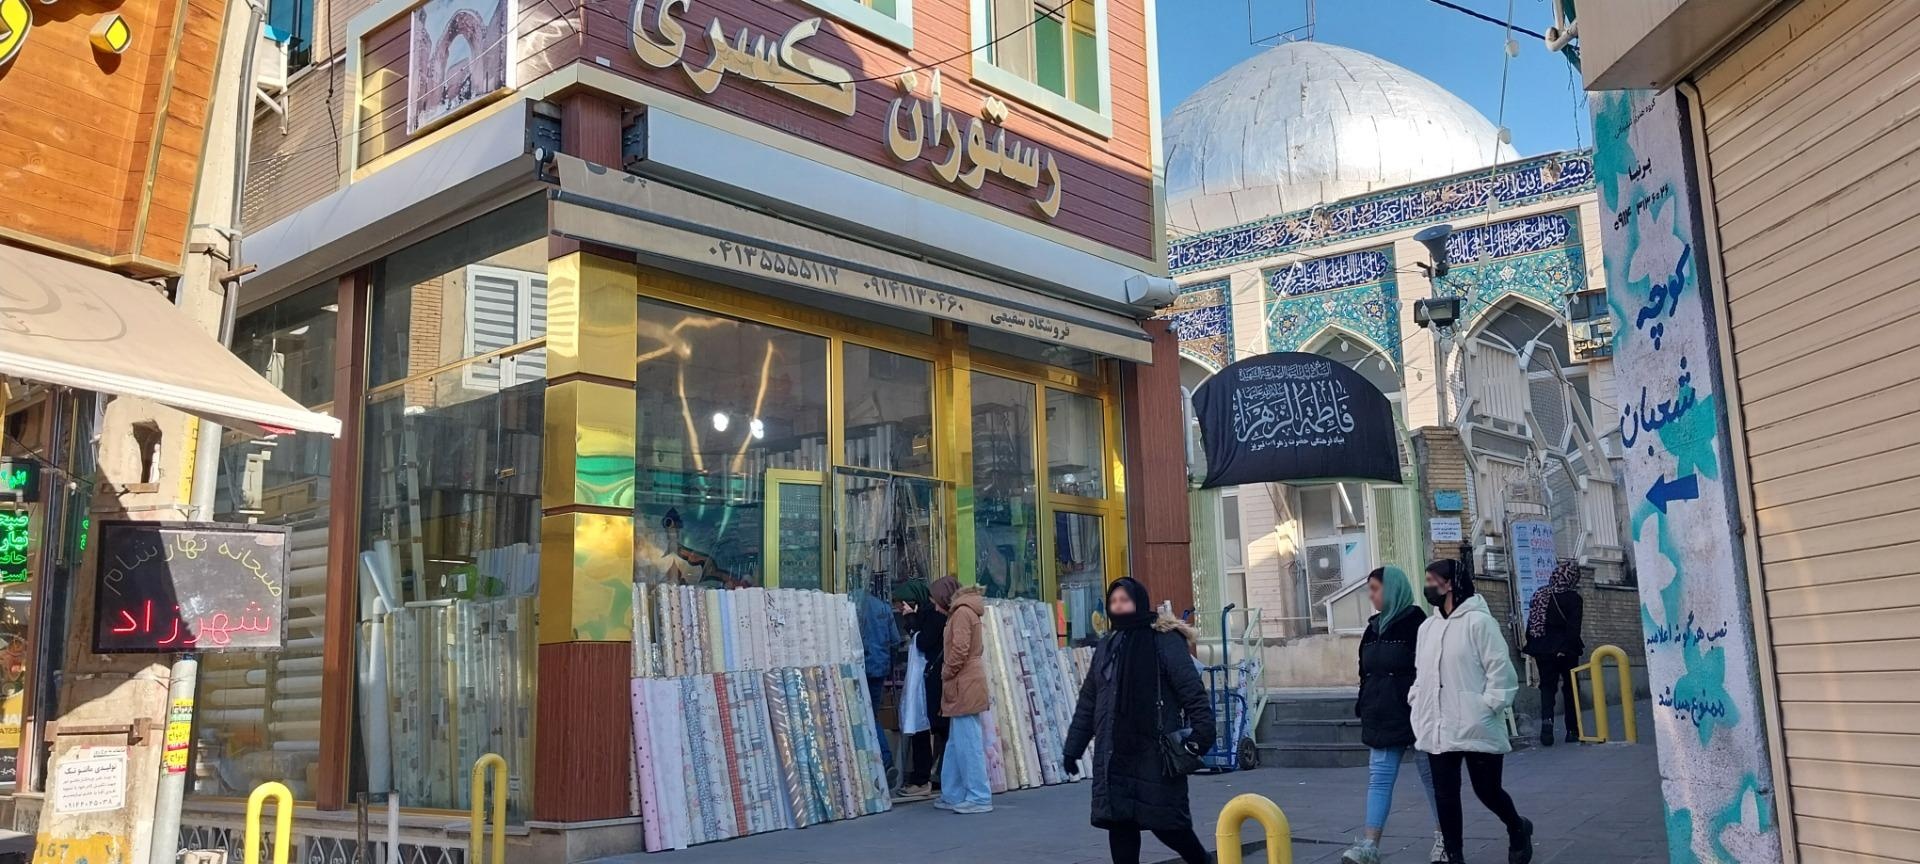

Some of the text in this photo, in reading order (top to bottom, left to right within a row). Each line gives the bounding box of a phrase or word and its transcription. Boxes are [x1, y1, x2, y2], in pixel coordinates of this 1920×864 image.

[628, 0, 1062, 218] رستوران کسری
[1636, 243, 1691, 351] کوچه
[1027, 319, 1071, 341] فروشگاه
[1620, 356, 1696, 457] شعبان
[102, 538, 159, 597] شام
[218, 541, 283, 598] صبحانه
[112, 599, 272, 645] شهرزاد
[1706, 620, 1728, 651] نصب
[1690, 688, 1725, 728] ممنوع
